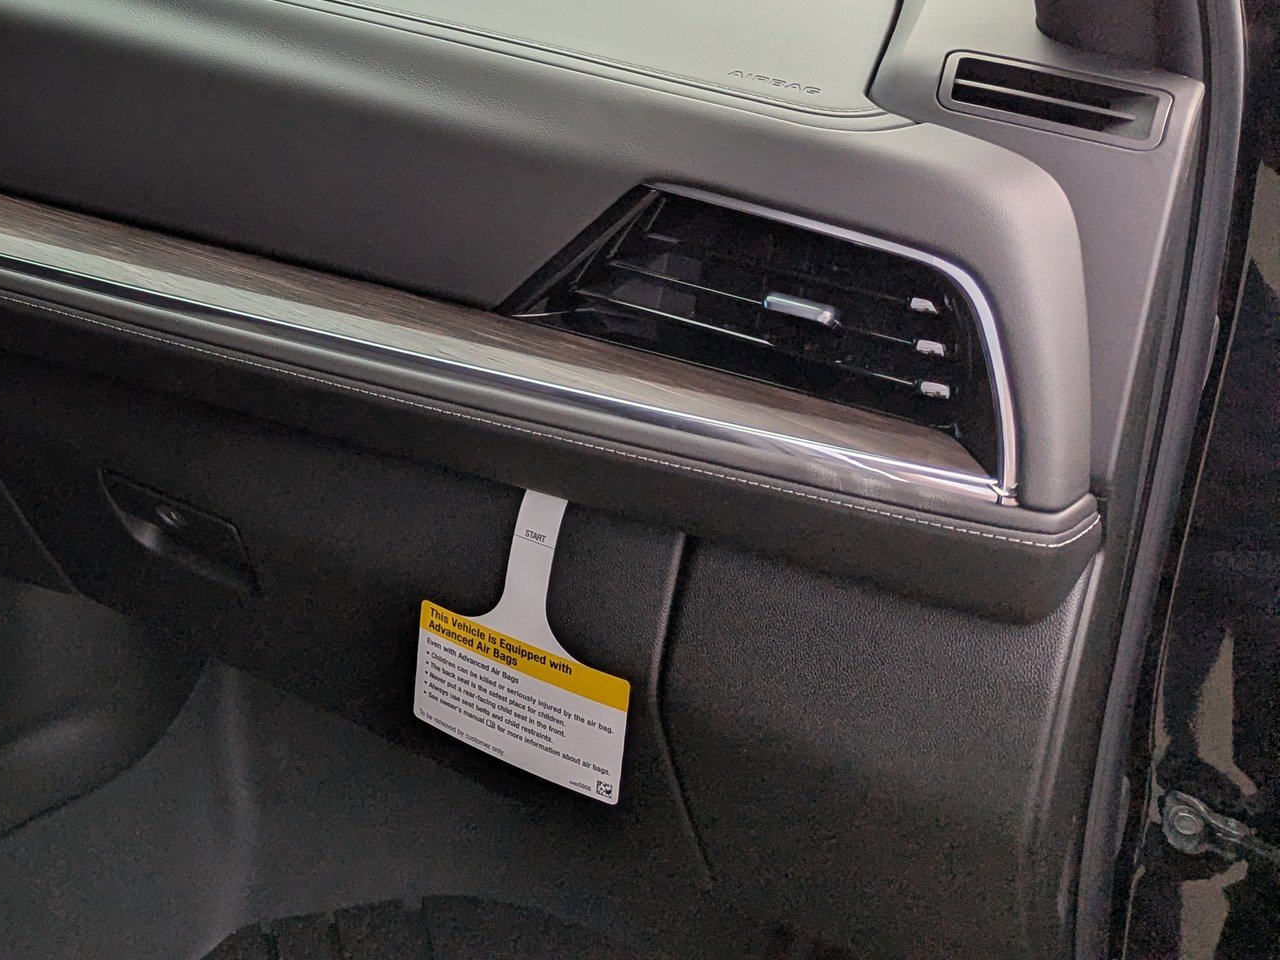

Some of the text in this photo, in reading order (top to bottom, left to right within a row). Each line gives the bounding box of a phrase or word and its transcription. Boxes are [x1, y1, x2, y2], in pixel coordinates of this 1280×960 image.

[727, 69, 822, 95] AIRBAG
[524, 528, 547, 543] START
[426, 636, 519, 684] Even with Advanced Air Bags
[428, 619, 518, 666] Advanced Air Bags
[429, 606, 572, 676] This Vehicle is Equipped with
[428, 681, 554, 744] Always use seat belts and child restraints.
[429, 671, 446, 685] Never
[446, 681, 457, 691] put
[497, 704, 513, 716] child
[513, 711, 528, 722] seat
[528, 716, 535, 725] in
[536, 720, 548, 730] the
[548, 725, 566, 738] front.
[430, 651, 614, 735] Children can be killed or seriously injured by the air bag.
[430, 661, 566, 727] The back seat is the safest place for children.
[419, 707, 505, 757] To be removed by customer only.
[428, 691, 439, 702] See
[463, 710, 485, 724] manual
[497, 724, 506, 734] for
[506, 730, 523, 742] more
[524, 736, 561, 757] information
[561, 753, 581, 765] about
[581, 760, 592, 769] air
[592, 763, 611, 777] bags.
